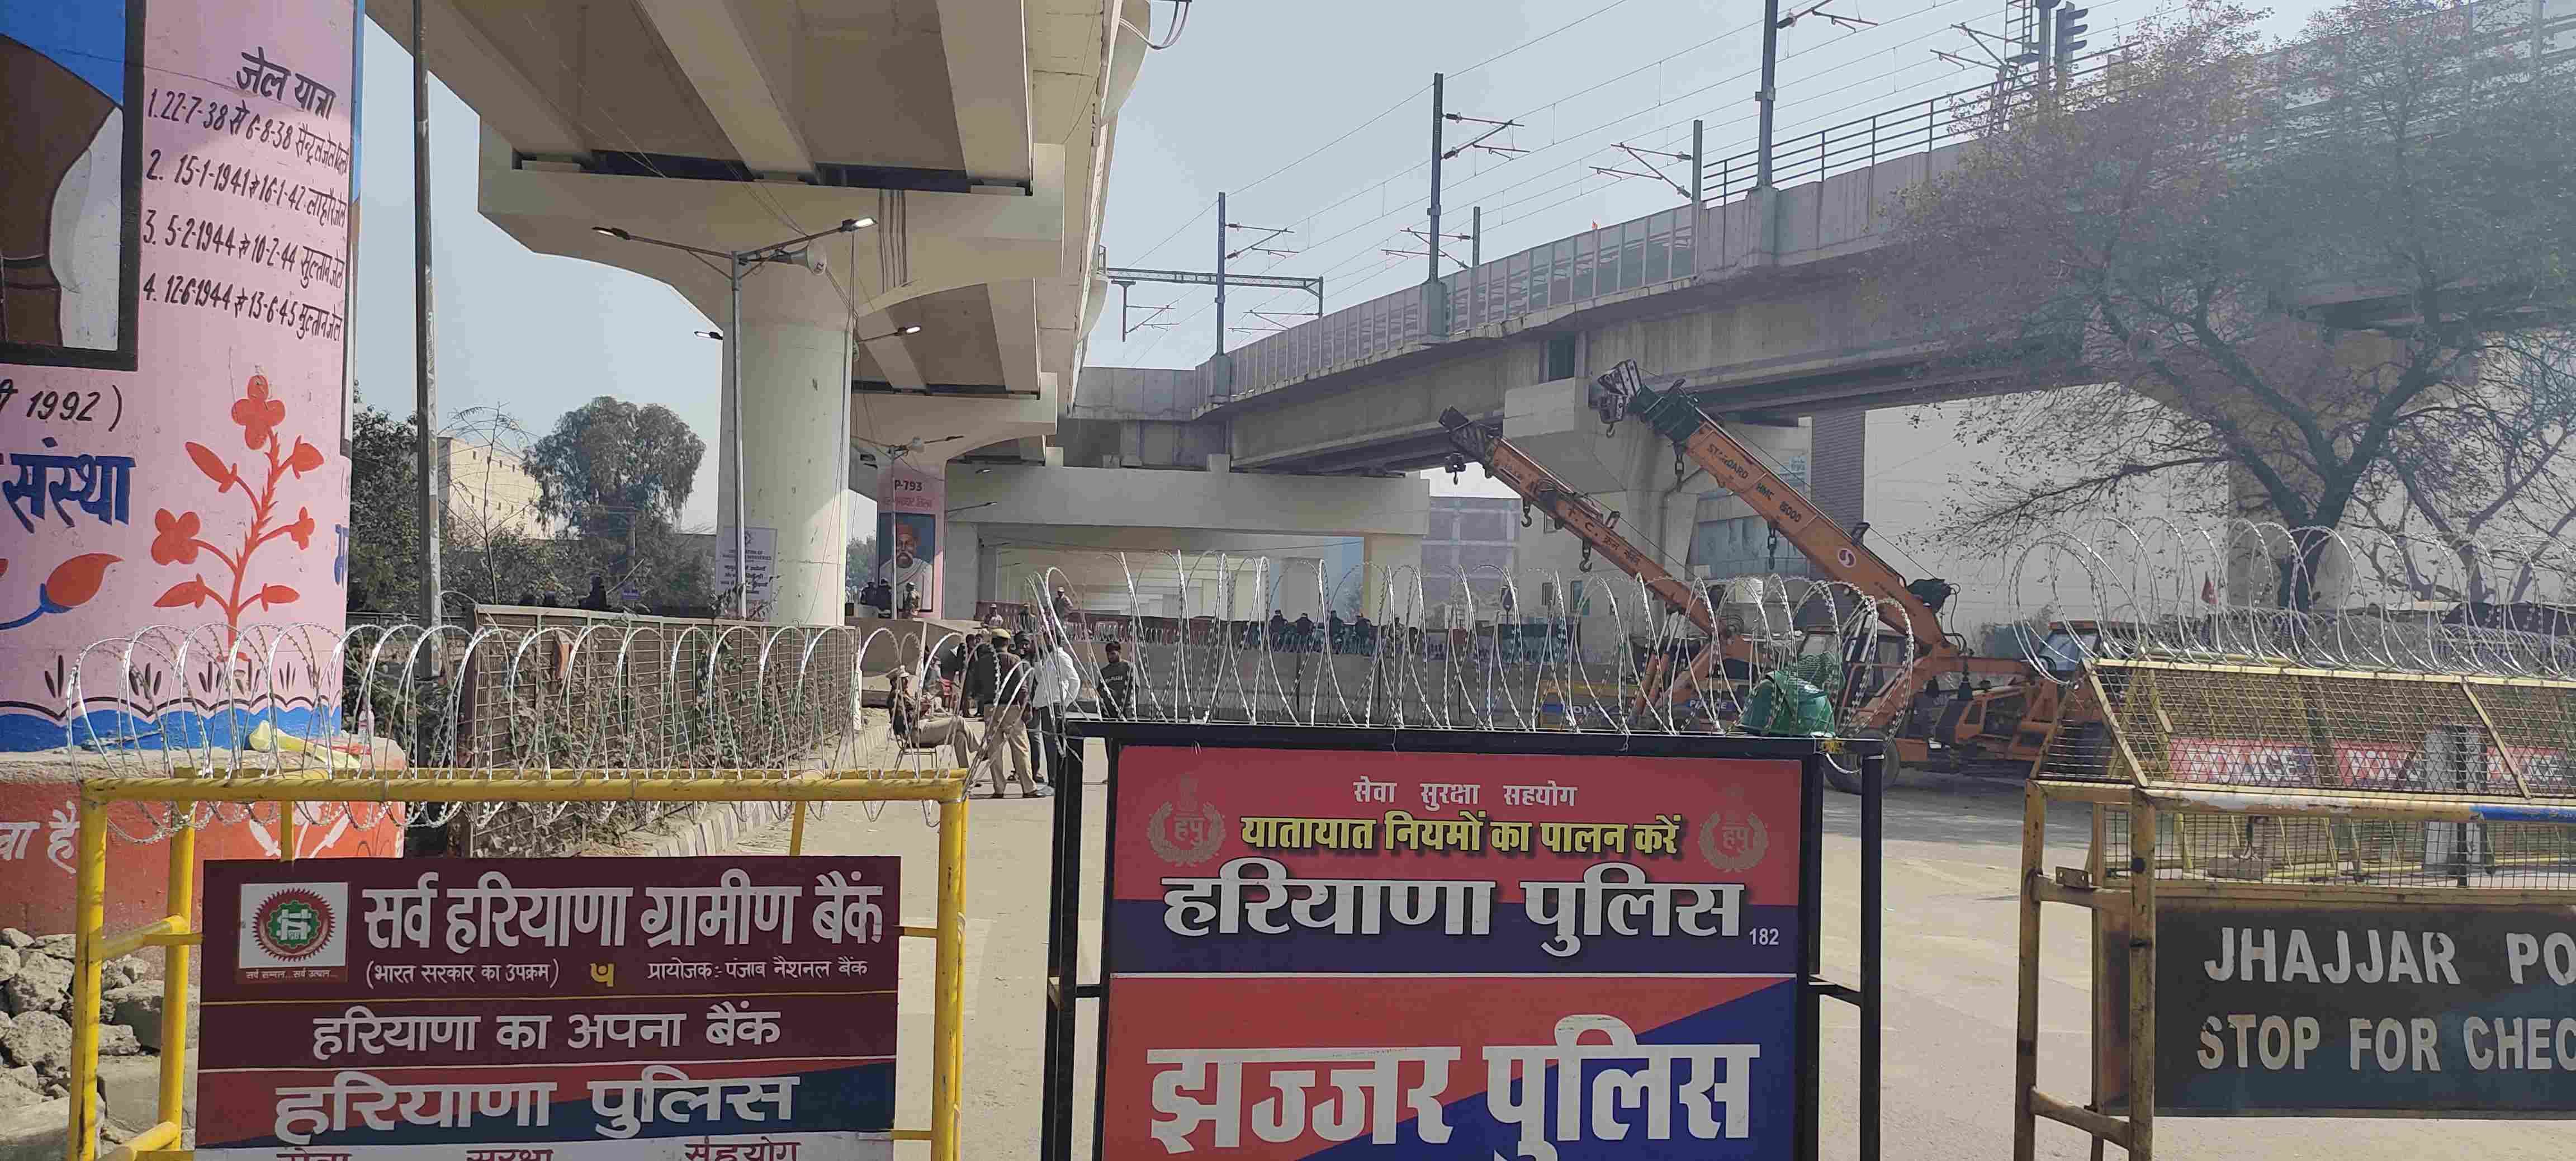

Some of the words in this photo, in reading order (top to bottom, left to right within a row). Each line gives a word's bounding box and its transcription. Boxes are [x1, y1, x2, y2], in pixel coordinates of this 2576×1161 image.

[236, 46, 291, 101] जेल
[295, 73, 336, 121] यात्रा
[146, 149, 163, 180] 2.
[174, 154, 251, 197] 15-1-1941
[143, 210, 157, 245] 3.
[165, 214, 236, 256] 5-2-1944
[252, 234, 298, 272] 10-2-44
[143, 273, 157, 301] 4.
[2, 437, 136, 534] संस्था
[895, 479, 922, 491] P-793
[1353, 776, 1397, 803] सेवा
[1420, 783, 1480, 811] सुरक्षा
[1503, 780, 1578, 806] सहयोग
[1240, 817, 1377, 850] यातायात
[1384, 810, 1487, 851] नियमों
[1490, 821, 1533, 852] का
[1540, 822, 1628, 853] पालन
[1633, 815, 1682, 855] करें
[362, 872, 438, 948] सर्व
[446, 871, 633, 954] हरियाणा
[640, 869, 802, 948] ग्रामीण
[812, 870, 883, 944] बैंक
[1161, 857, 1497, 937] हरियाणा
[1520, 862, 1745, 957] पुलिस
[1749, 928, 1779, 946] 182
[2204, 927, 2460, 985] JHAJJAR
[2506, 932, 2576, 986] PO
[366, 960, 415, 989] (भारत
[421, 964, 475, 982] सरकार
[482, 963, 501, 981] का
[505, 959, 559, 988] उपक्रम)
[725, 958, 766, 979] पंजाब
[774, 957, 832, 979] नैशनल
[839, 956, 868, 976] बैंक
[313, 1006, 481, 1060] हरियाणा
[496, 1016, 552, 1049] का
[568, 1013, 686, 1048] अपना
[706, 1001, 781, 1046] बैंक
[2196, 1014, 2320, 1070] STOP
[2350, 1017, 2441, 1072] FOR
[2463, 1016, 2576, 1072] CHEC
[275, 1072, 557, 1145] हरियाणा
[588, 1065, 800, 1139] पुलिस
[1147, 1047, 1461, 1154] झज्जर
[1482, 1014, 1760, 1161] पुलिस
